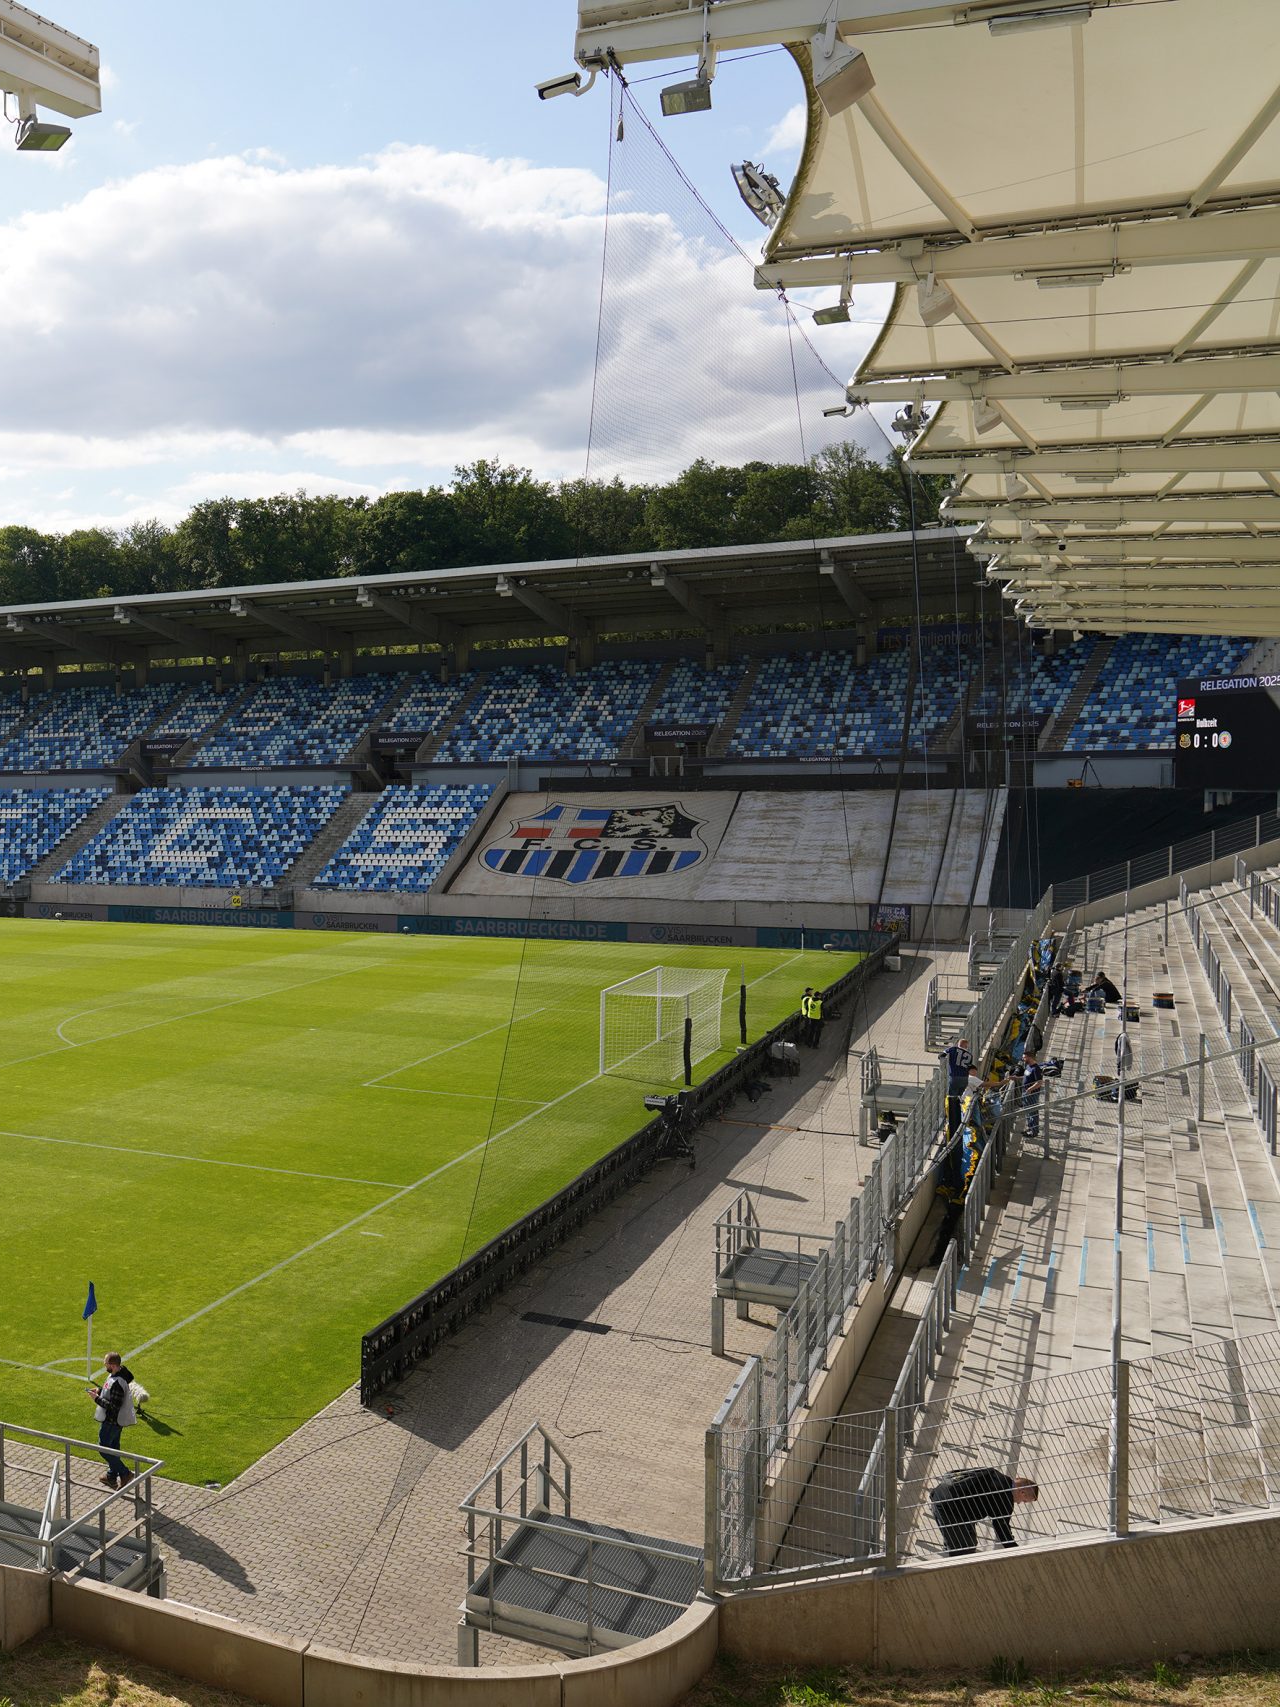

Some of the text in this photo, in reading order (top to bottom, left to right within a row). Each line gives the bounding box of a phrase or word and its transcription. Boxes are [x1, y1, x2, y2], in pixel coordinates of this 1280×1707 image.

[1200, 677, 1257, 691] RELEGATION
[976, 721, 1021, 729] RELEGTION
[1194, 733, 1200, 748] 0
[1212, 732, 1218, 748] 0
[155, 909, 278, 925] SAARBRUECKEN.DE
[455, 920, 607, 937] SAARBRUECKEN.DE
[956, 1049, 972, 1067] 12
